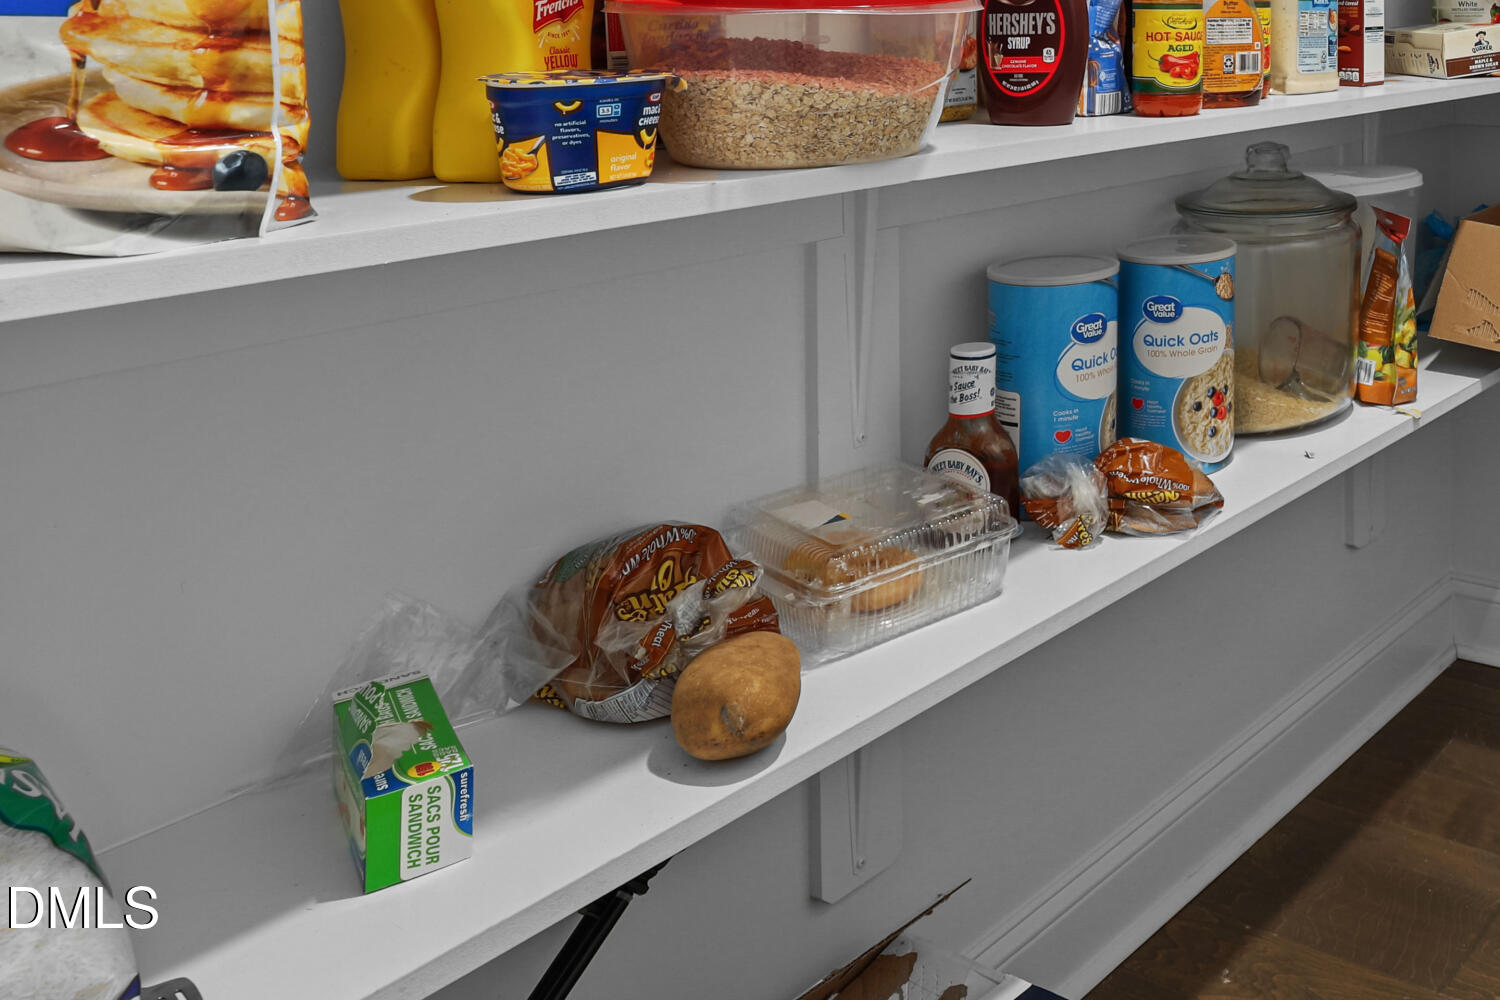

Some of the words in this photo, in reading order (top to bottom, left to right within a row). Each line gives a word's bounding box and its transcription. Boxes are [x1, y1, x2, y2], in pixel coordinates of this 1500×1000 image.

[988, 12, 1056, 35] HERSHEY'S
[1007, 36, 1031, 50] SYRUP
[1146, 32, 1171, 42] HOT
[1175, 32, 1203, 42] SAUC
[1167, 44, 1194, 52] AGED
[1472, 45, 1493, 53] QUAKER
[544, 54, 579, 72] YELLOW
[551, 132, 591, 141] preservatives,
[569, 139, 582, 147] dyes
[610, 152, 637, 164] original
[610, 162, 632, 171] flavor
[1146, 301, 1176, 312] Great
[1153, 308, 1176, 318] Value
[1076, 319, 1103, 333] Great
[1083, 328, 1103, 338] Value
[1143, 334, 1185, 348] Quick
[1189, 330, 1219, 346] Oats
[1146, 349, 1167, 358] 100%
[1169, 347, 1197, 358] Whole
[1197, 345, 1218, 356] Grain
[1071, 352, 1108, 371] Quick
[1075, 372, 1096, 383] 100%
[954, 380, 976, 392] Sauce
[959, 389, 981, 403] Boss!
[1052, 409, 1072, 417] Cooks
[1057, 414, 1079, 422] minute
[947, 460, 965, 470] BABY
[965, 464, 984, 484] RAY'S
[1140, 476, 1172, 491] Whole
[641, 527, 680, 555] Whole
[459, 772, 469, 822] surefresh
[427, 785, 442, 824] SACS
[407, 793, 423, 870] SANDWICH
[425, 827, 441, 866] POUR
